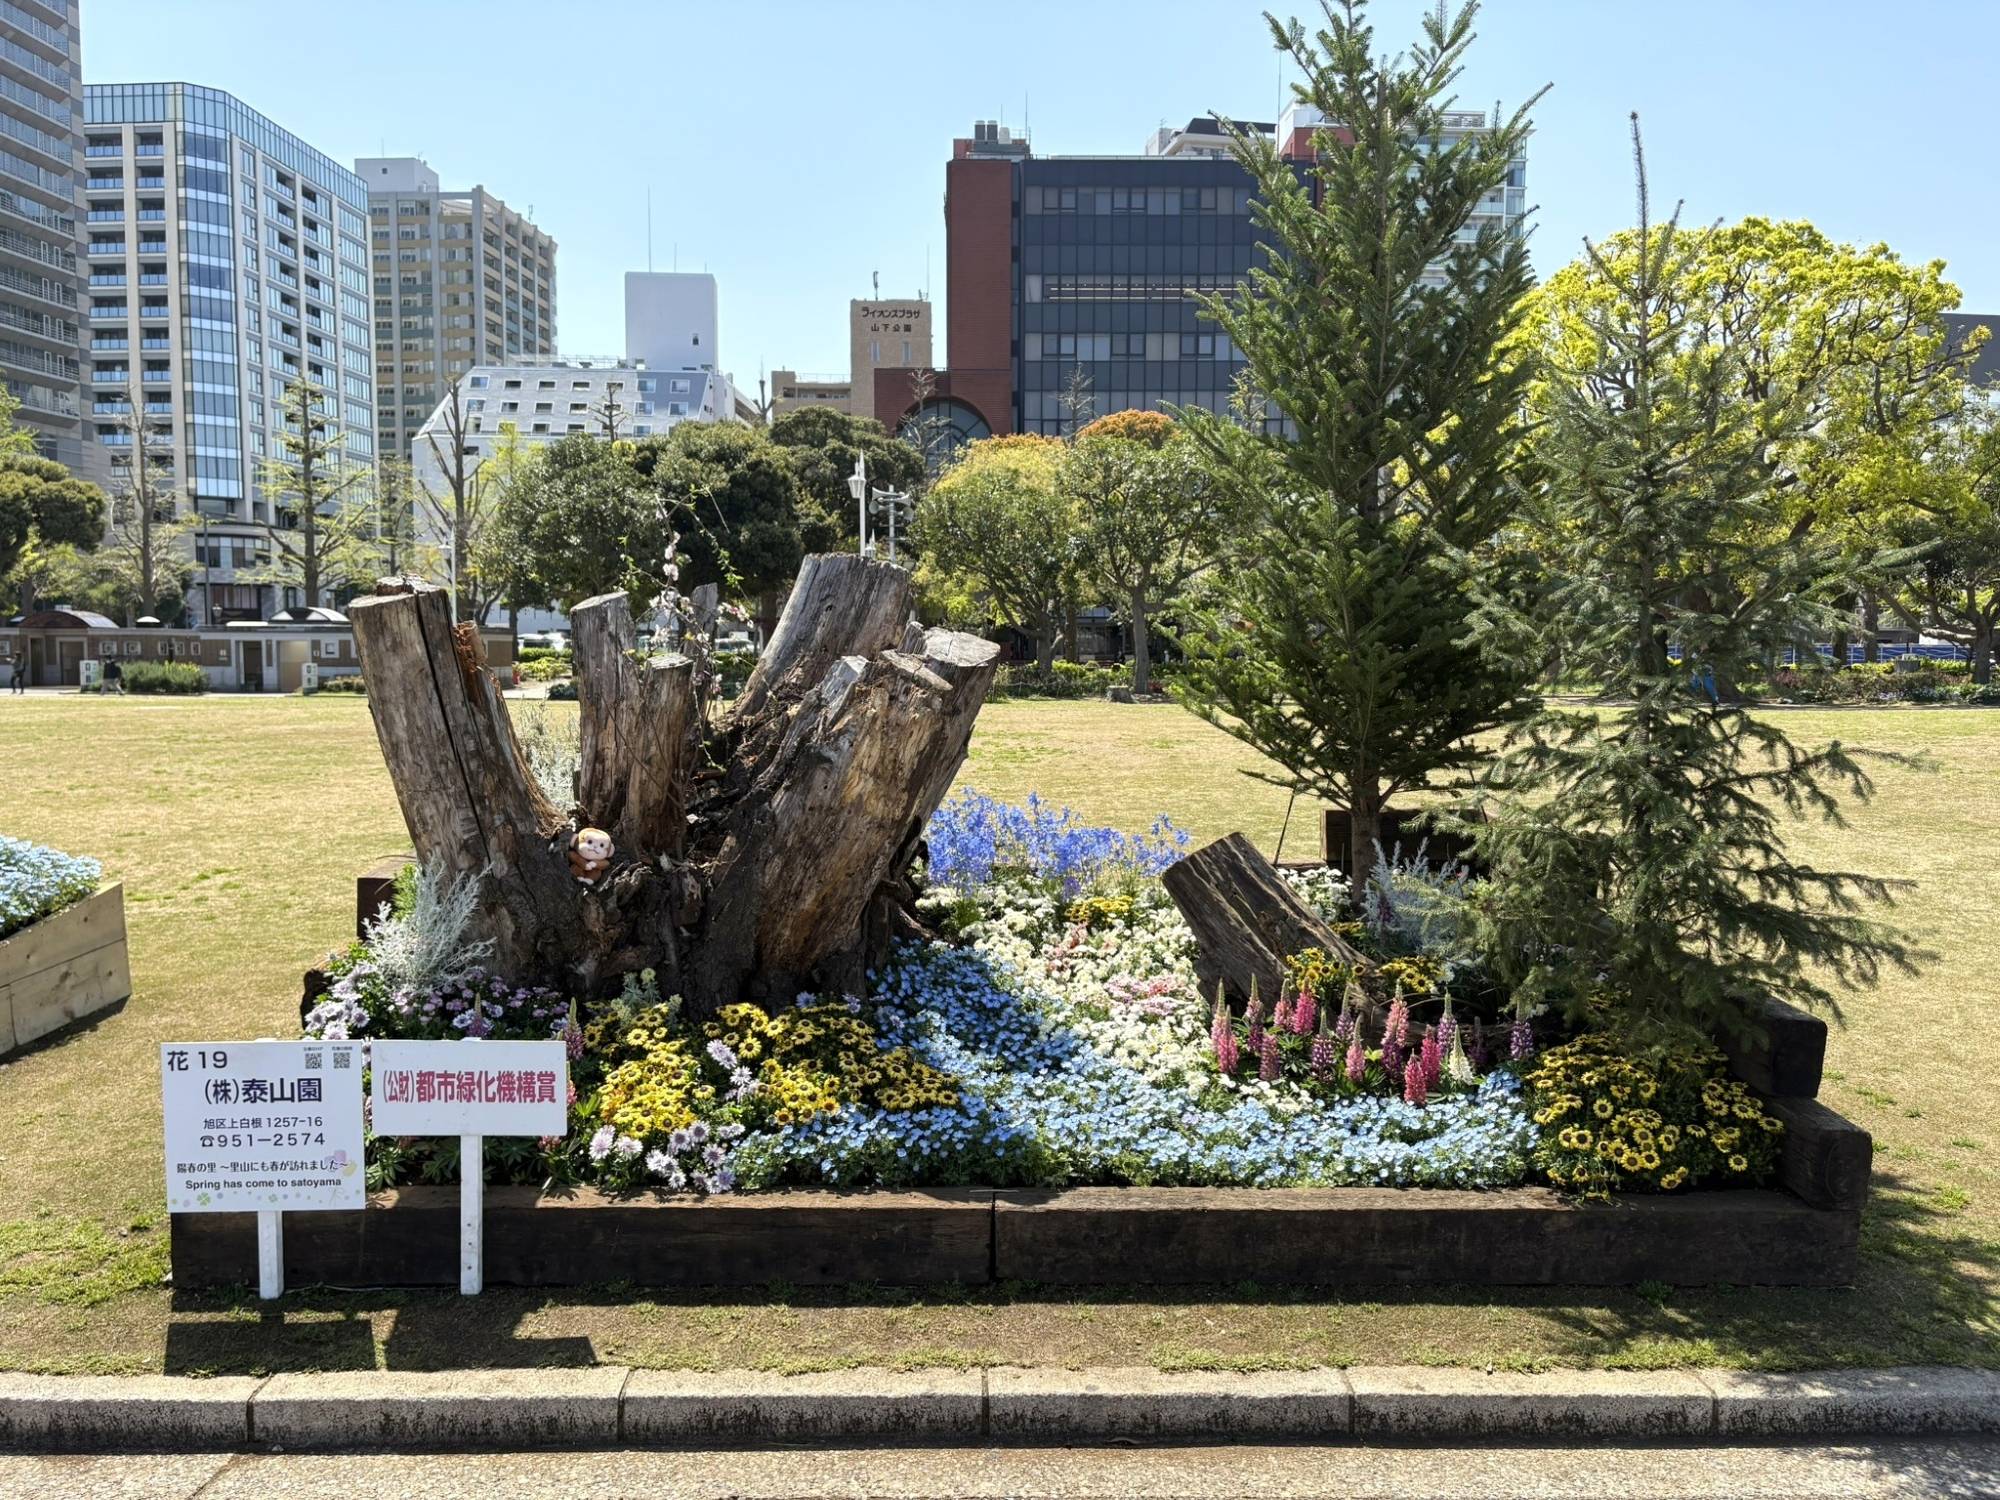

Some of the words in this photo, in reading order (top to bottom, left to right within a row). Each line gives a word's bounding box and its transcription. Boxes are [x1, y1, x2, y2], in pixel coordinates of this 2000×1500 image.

[871, 323, 912, 333] 山下公園
[167, 1050, 189, 1072] 花
[198, 1051, 228, 1069] 19
[204, 1077, 323, 1105] (株)泰山園
[383, 1069, 556, 1104] (公財)都市緑化機構賞
[203, 1117, 263, 1130] 旭区上白根
[266, 1116, 323, 1128] 1257-16
[185, 1179, 221, 1190] Spring
[223, 1179, 243, 1189] has
[245, 1180, 275, 1188] come
[277, 1179, 288, 1188] to
[290, 1178, 342, 1189] satoyama
